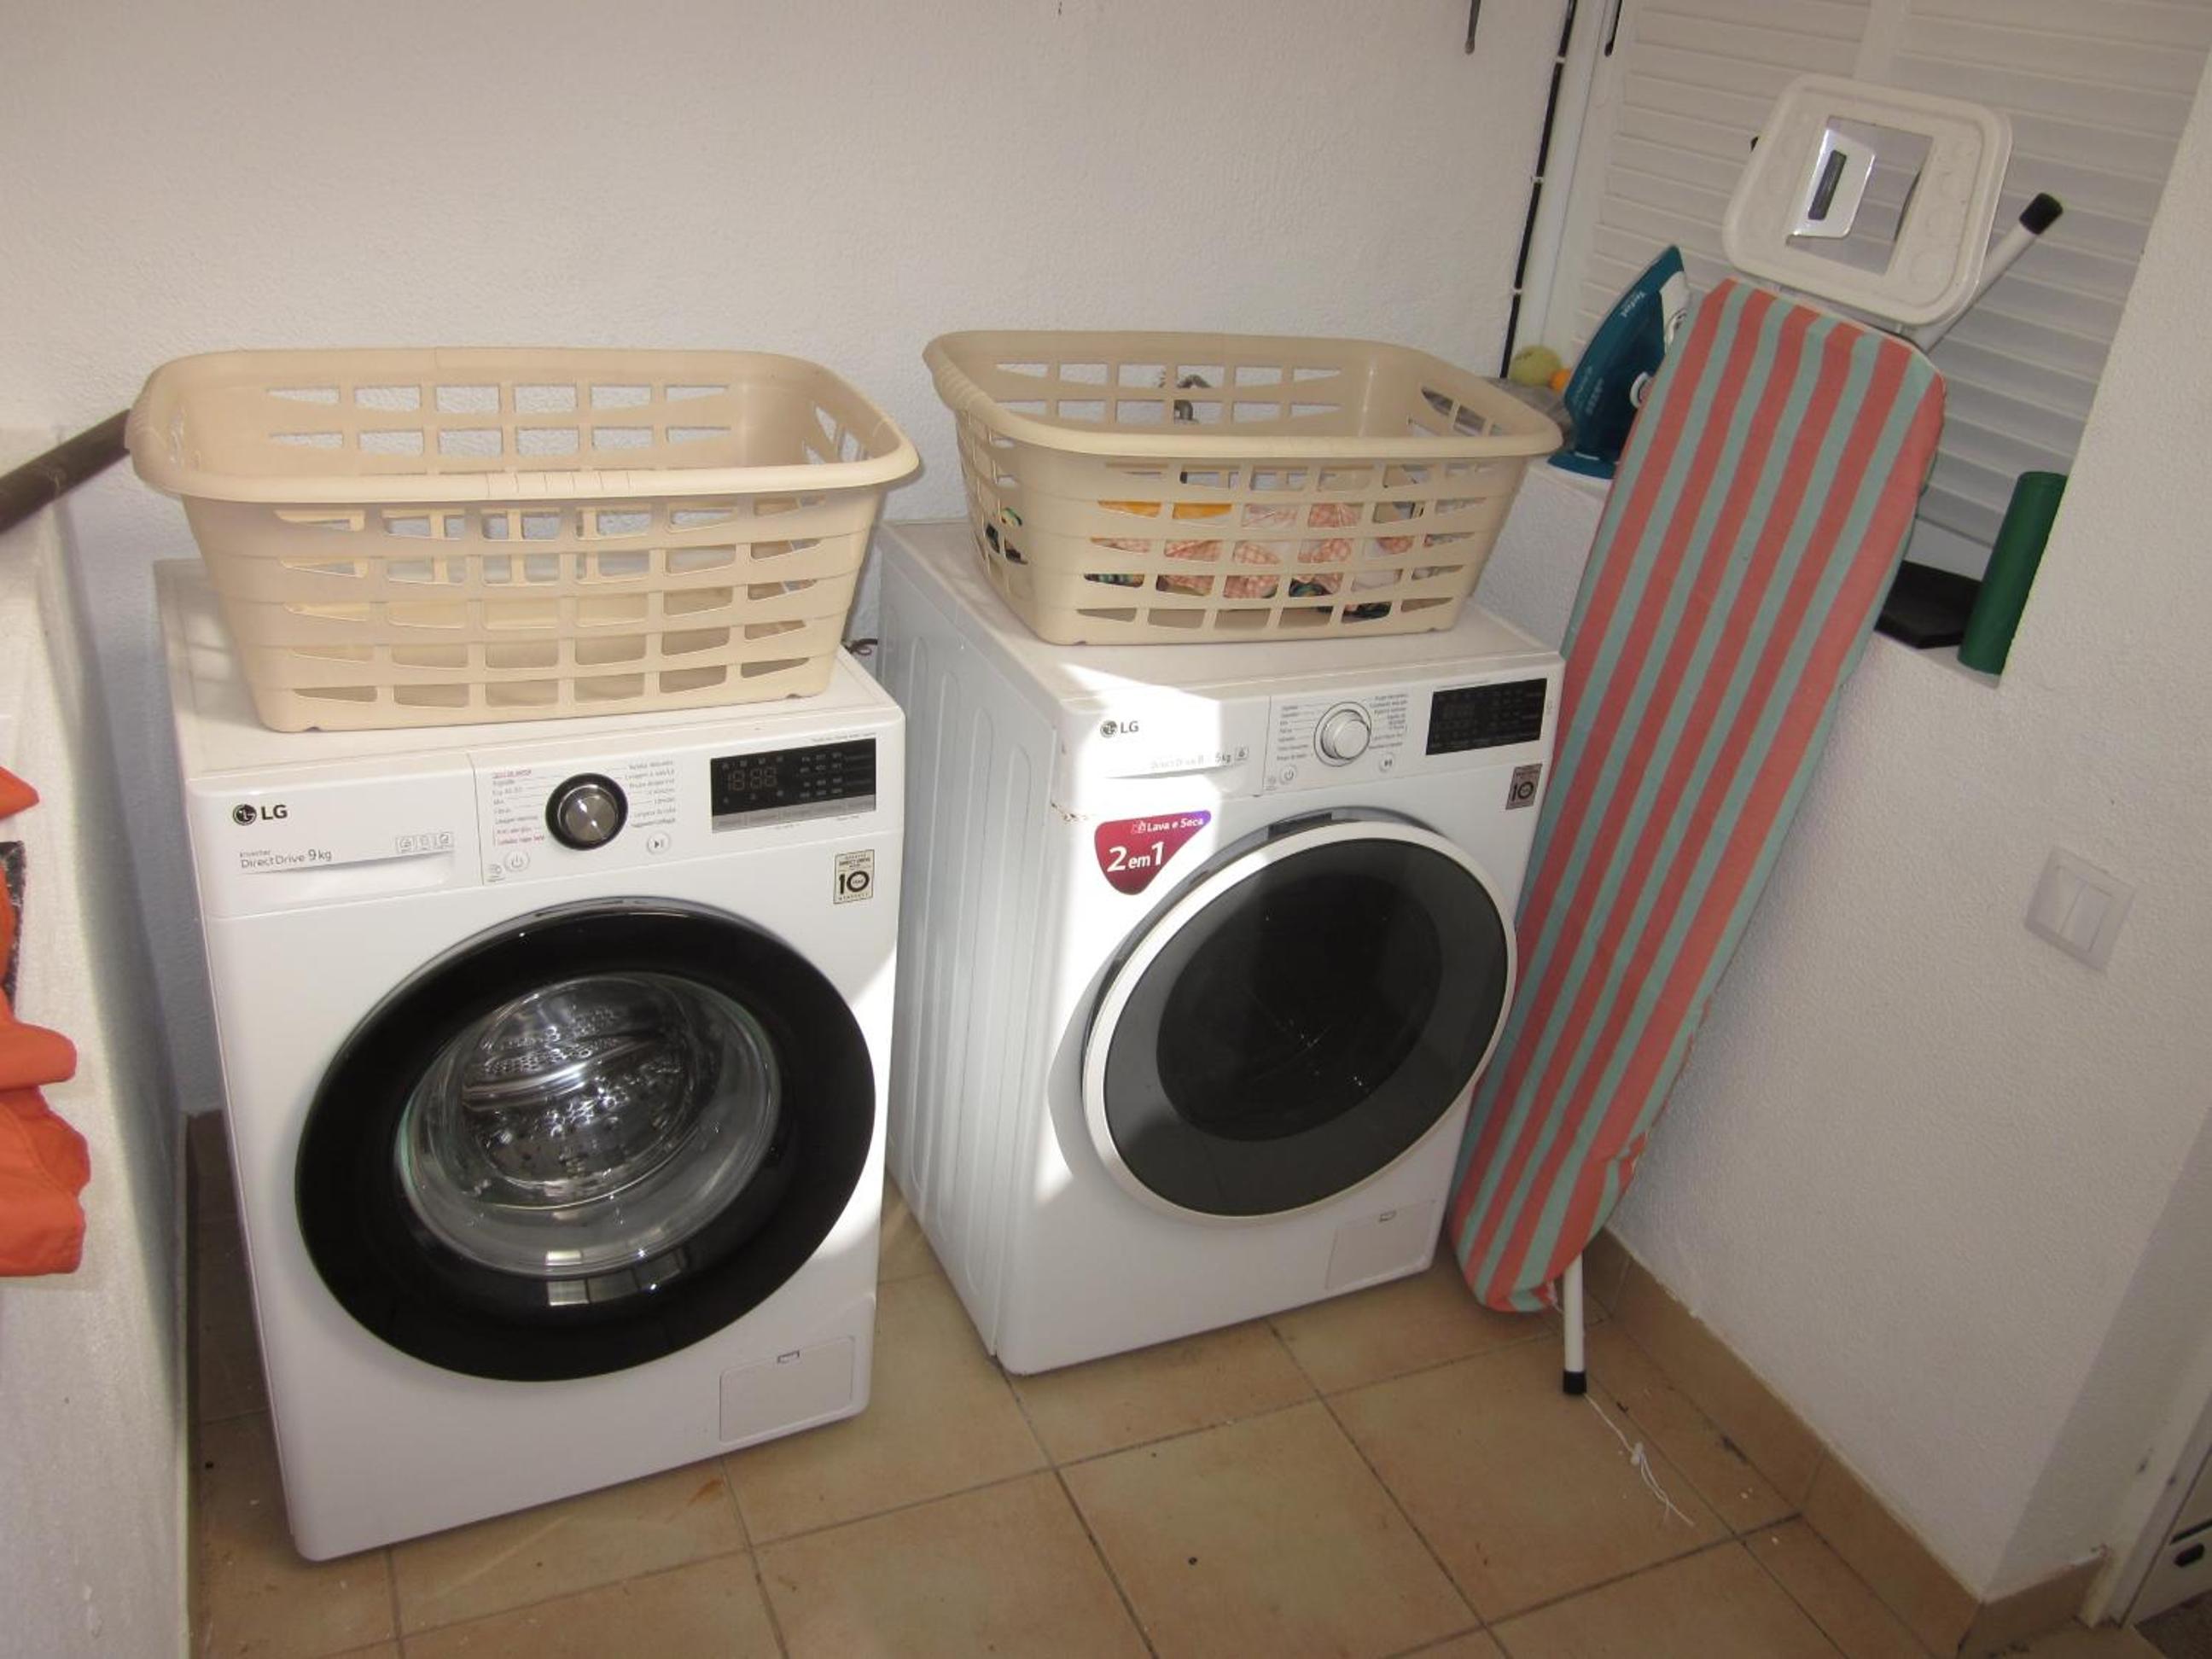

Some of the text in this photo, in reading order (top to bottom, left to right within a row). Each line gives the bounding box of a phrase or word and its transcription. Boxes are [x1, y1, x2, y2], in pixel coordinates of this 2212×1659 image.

[1120, 720, 1139, 734] LG
[1511, 781, 1534, 802] 10
[260, 804, 288, 820] LG
[1147, 821, 1170, 832] Lava
[1180, 817, 1204, 828] Seca
[1107, 841, 1165, 872] 2 em 1
[839, 870, 870, 894] 10
